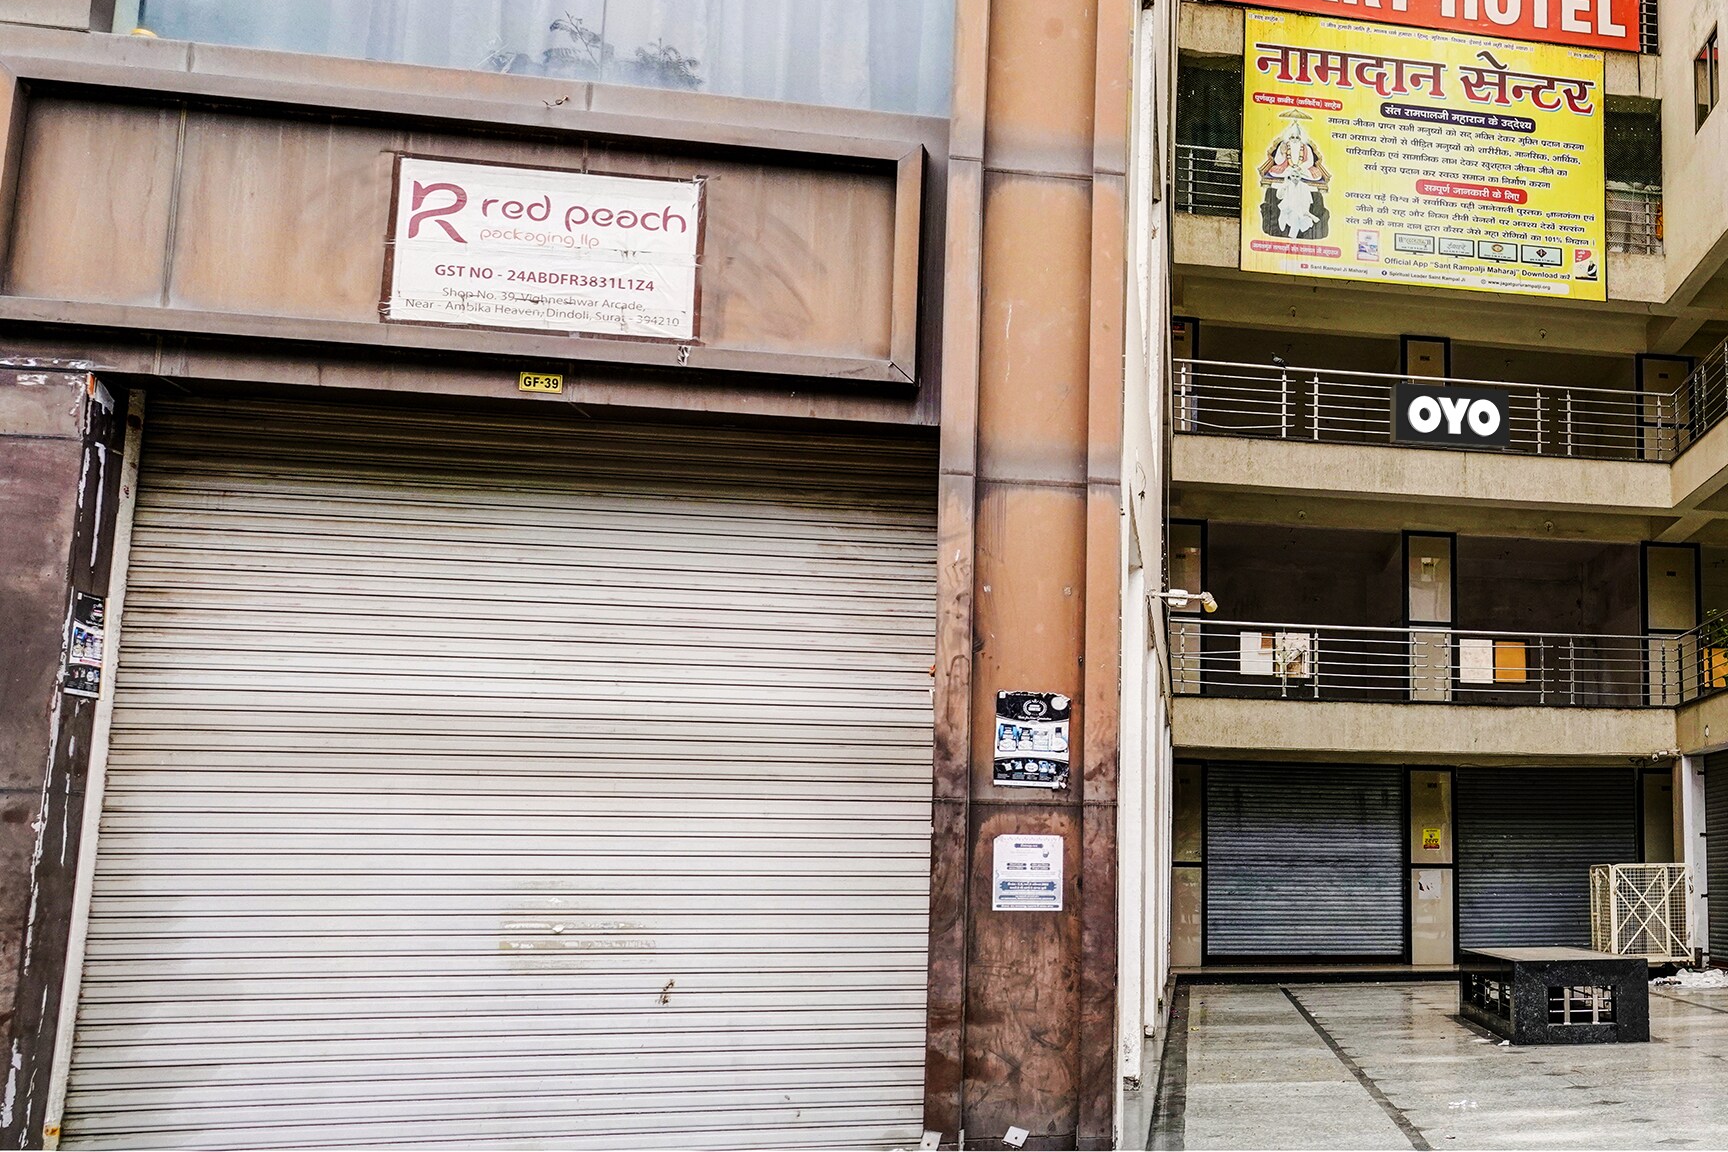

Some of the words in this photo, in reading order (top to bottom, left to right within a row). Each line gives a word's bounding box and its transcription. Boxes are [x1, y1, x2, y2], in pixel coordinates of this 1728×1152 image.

[1257, 44, 1444, 95] नामदान
[1460, 52, 1593, 113] सेन्टर
[1384, 105, 1401, 115] संत
[1404, 108, 1448, 119] रामपालजी
[1451, 113, 1485, 124] महाराज
[1487, 116, 1498, 125] के
[1352, 117, 1375, 127] जीवन
[1398, 123, 1414, 131] सभी
[1417, 126, 1442, 135] मनुष्यों
[1445, 128, 1456, 136] को
[1474, 131, 1494, 140] भक्ति
[1497, 133, 1515, 142] देकर
[1518, 135, 1538, 146] मुक्ति
[1562, 142, 1584, 150] करना
[1379, 135, 1397, 143] रोगों
[1400, 137, 1407, 145] से
[1435, 142, 1460, 152] मनुष्यों
[1463, 144, 1474, 152] को
[1345, 146, 1385, 156] पारिवारिक
[1388, 150, 1398, 159] एवं
[1402, 153, 1438, 162] सामाजिक
[1460, 157, 1478, 166] देकर
[1481, 161, 1511, 171] खुशहाल
[1514, 163, 1535, 172] जीवन
[1538, 165, 1554, 174] जीने
[1364, 162, 1377, 170] सर्व
[1380, 165, 1396, 174] सुख
[1438, 171, 1459, 179] स्वच्छ
[1462, 173, 1485, 181] समाज
[1501, 175, 1526, 185] निर्माण
[1528, 180, 1550, 188] करना
[1423, 183, 1450, 194] सम्पूर्ण
[1452, 187, 1489, 196] जानकारी
[1491, 189, 1501, 198] के
[1504, 190, 1519, 201] लिए
[481, 195, 551, 222] red
[564, 206, 687, 233] peach
[479, 227, 576, 248] packaging
[434, 264, 465, 278] GST
[470, 267, 493, 279] NO
[507, 269, 655, 292] 24ABDFR3831L1Z4
[1384, 257, 1411, 265] Official
[1452, 263, 1485, 273] Rampalji
[1521, 269, 1557, 278] Download
[405, 299, 434, 310] Near
[445, 300, 491, 314] Ambika
[546, 308, 592, 321] Dindoli,
[442, 286, 475, 302] Shop
[477, 289, 497, 301] No.
[520, 292, 599, 309] Vighneshwar
[602, 299, 646, 312] Arcade,
[523, 376, 559, 389] GF-39
[1407, 395, 1501, 438] OYO
